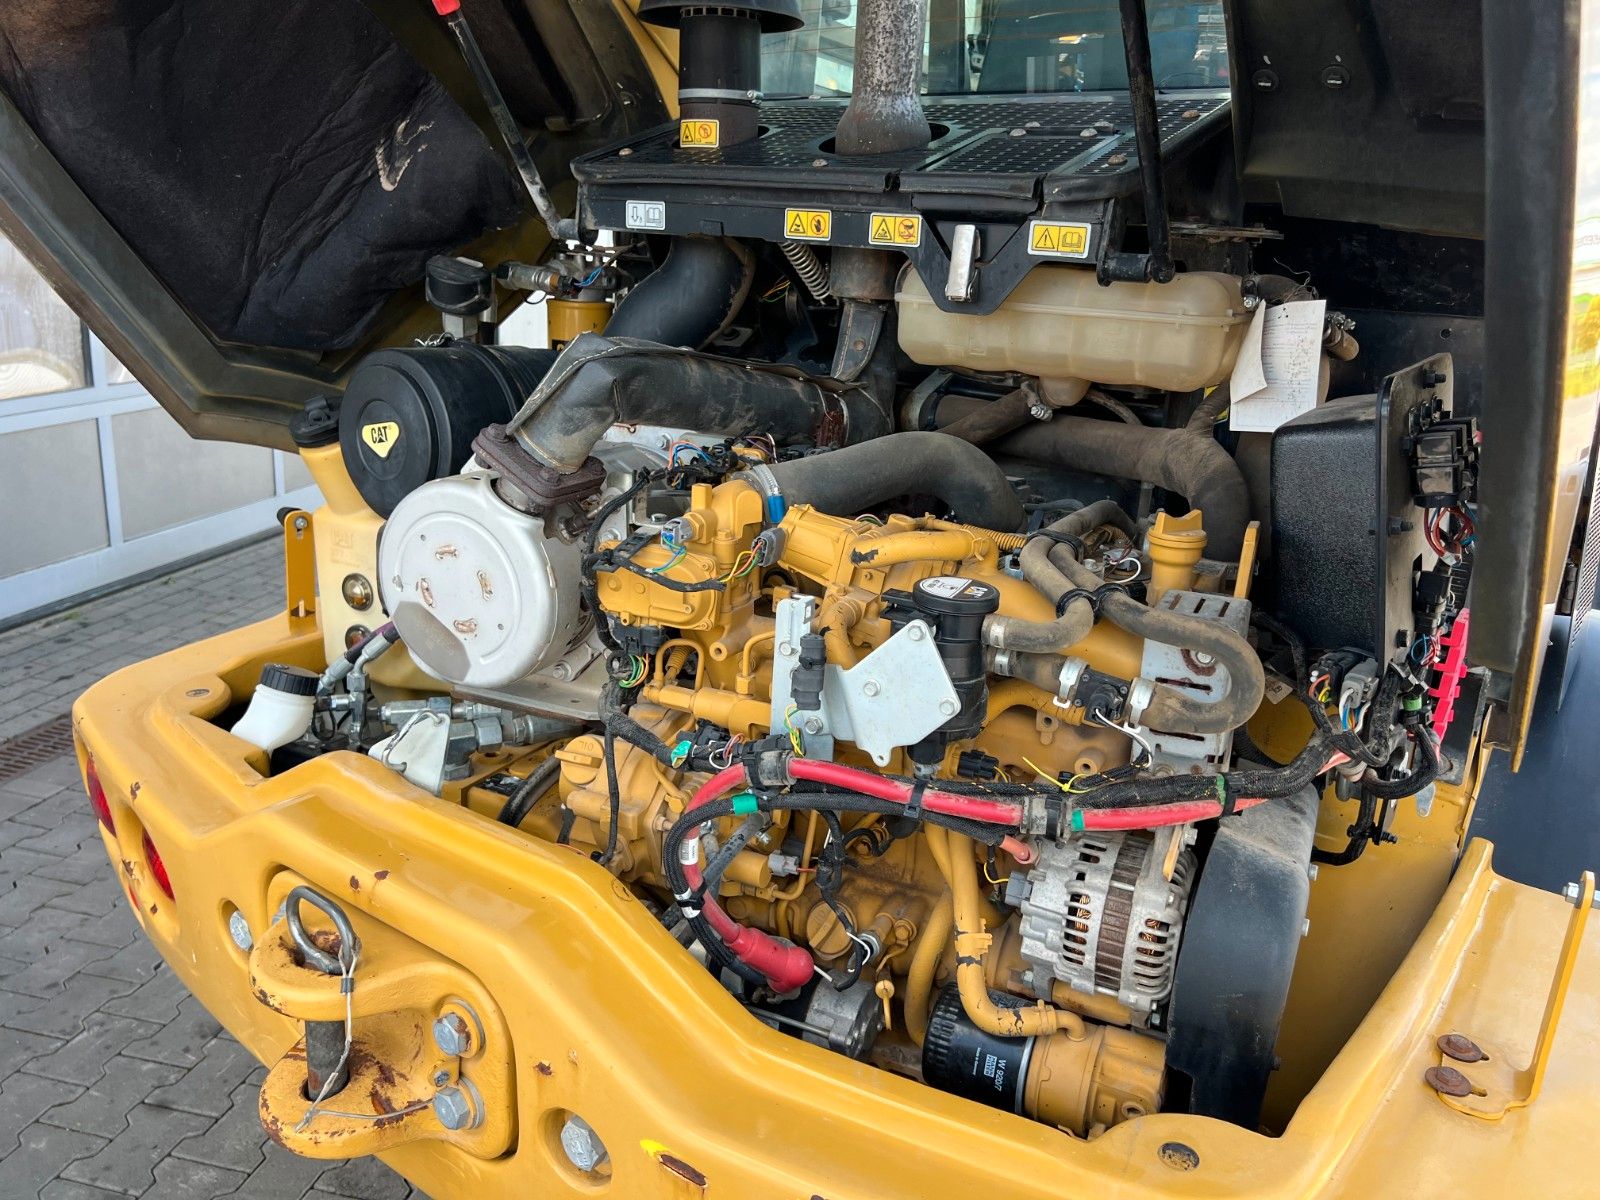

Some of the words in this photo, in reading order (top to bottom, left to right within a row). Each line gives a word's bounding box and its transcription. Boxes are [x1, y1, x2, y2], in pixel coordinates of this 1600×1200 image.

[371, 426, 388, 443] CAT
[998, 1059, 1007, 1070] W
[994, 1069, 1004, 1092] 920/7
